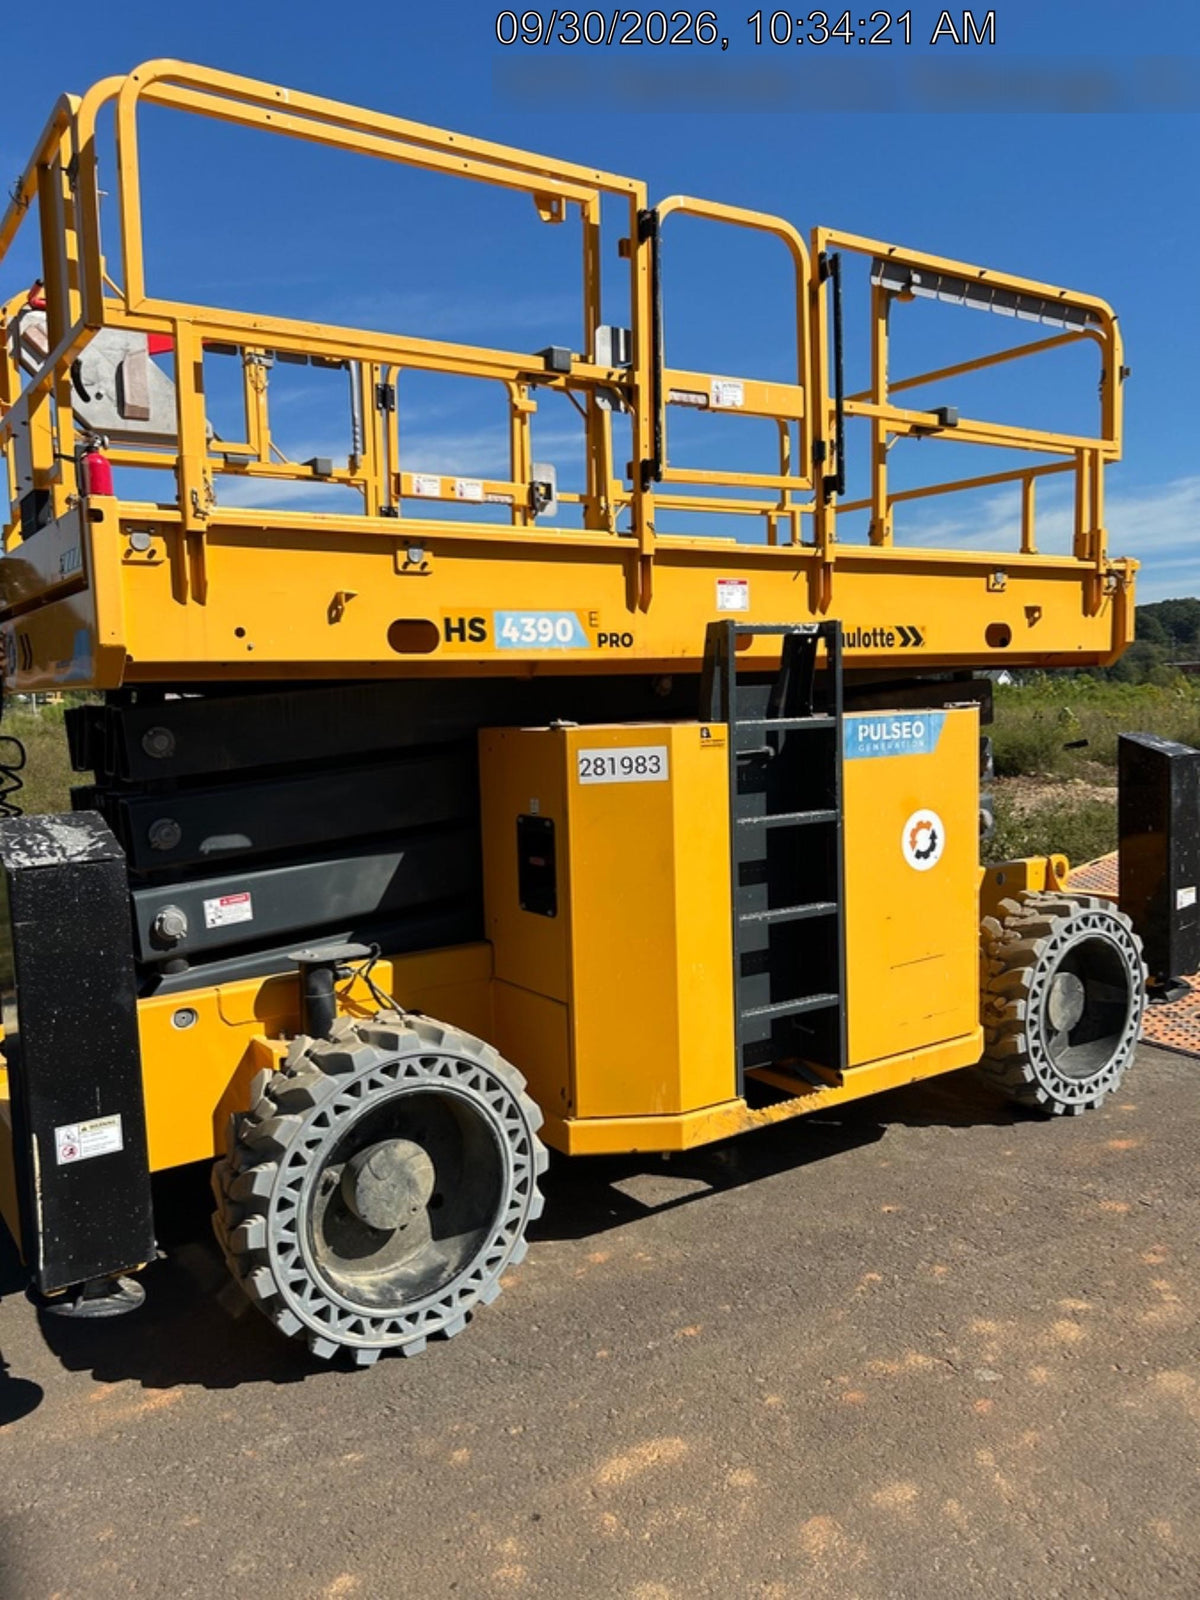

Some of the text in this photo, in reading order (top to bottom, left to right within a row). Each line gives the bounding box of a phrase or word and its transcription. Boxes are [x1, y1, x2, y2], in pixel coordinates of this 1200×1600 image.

[444, 610, 599, 643] HS 4390 E
[597, 632, 634, 649] PRO
[858, 720, 925, 742] PULSEO
[579, 754, 661, 778] 281983
